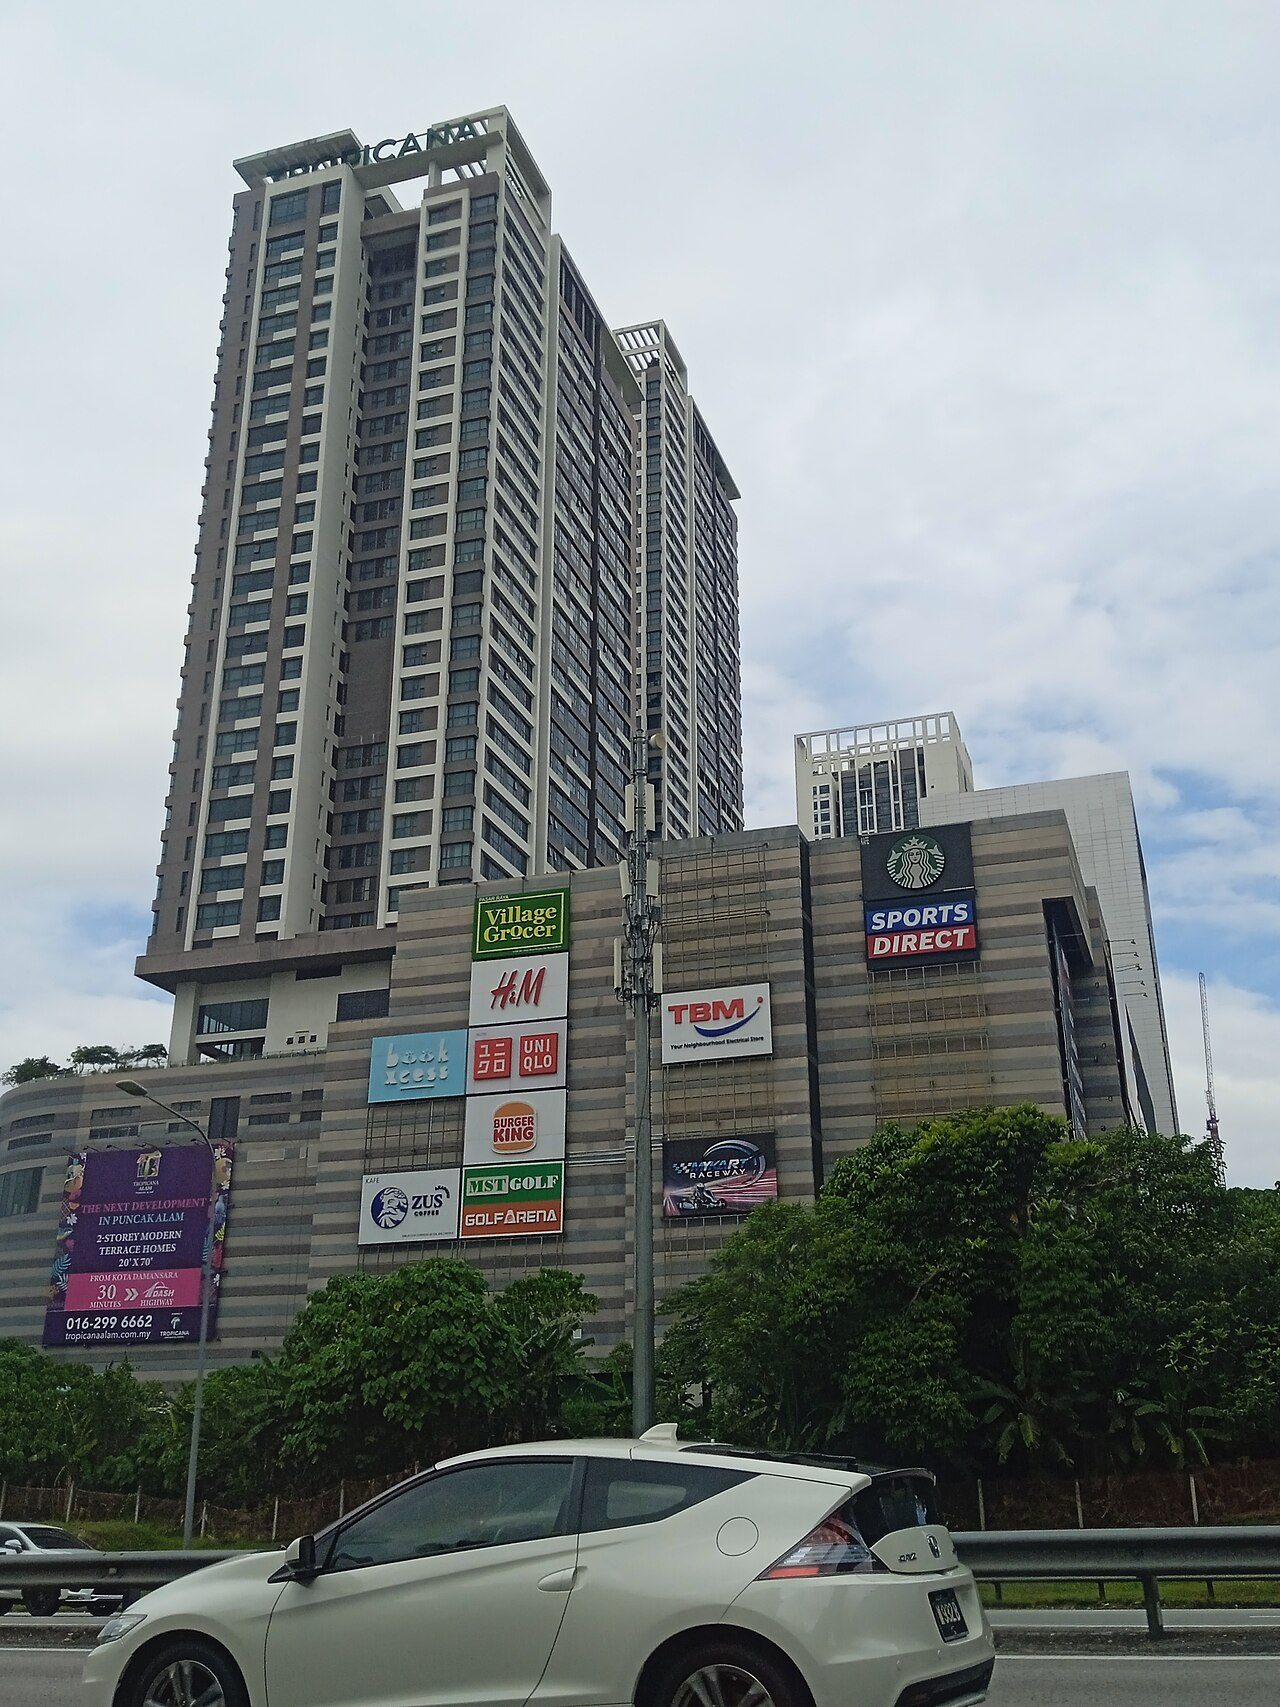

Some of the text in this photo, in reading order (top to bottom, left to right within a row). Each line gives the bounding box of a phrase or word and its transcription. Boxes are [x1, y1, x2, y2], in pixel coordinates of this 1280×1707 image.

[485, 906, 557, 925] Village
[872, 904, 968, 930] SPORTS
[484, 925, 556, 942] Grocer
[873, 928, 969, 955] DIRECT
[491, 966, 546, 1010] H&M
[668, 998, 744, 1025] TBM
[524, 1039, 550, 1054] UNI
[684, 1040, 726, 1049] Neighbourhood
[524, 1054, 552, 1072] QLO
[494, 1116, 534, 1128] BURGER
[493, 1126, 534, 1142] KING
[690, 1168, 746, 1178] RACEWAY
[468, 1178, 506, 1194] MST
[509, 1175, 558, 1190] GOLF
[82, 1198, 207, 1214] THE NEXT DEVELOPMENT
[412, 1194, 443, 1209] ZUS
[98, 1212, 184, 1226] IN PUNCAK ALAM
[96, 1230, 182, 1243] 2-STOREY MODERN
[99, 1243, 176, 1256] TERRACE HOMES
[118, 1257, 154, 1268] 20' X 70'
[132, 1272, 178, 1280] DAMANSARA
[98, 1284, 116, 1300] 30
[153, 1289, 175, 1297] DASH
[140, 1299, 174, 1307] HIGHWAY
[66, 1315, 152, 1329] 016-299 6662
[65, 1330, 151, 1342] tropicanaalam.com.my
